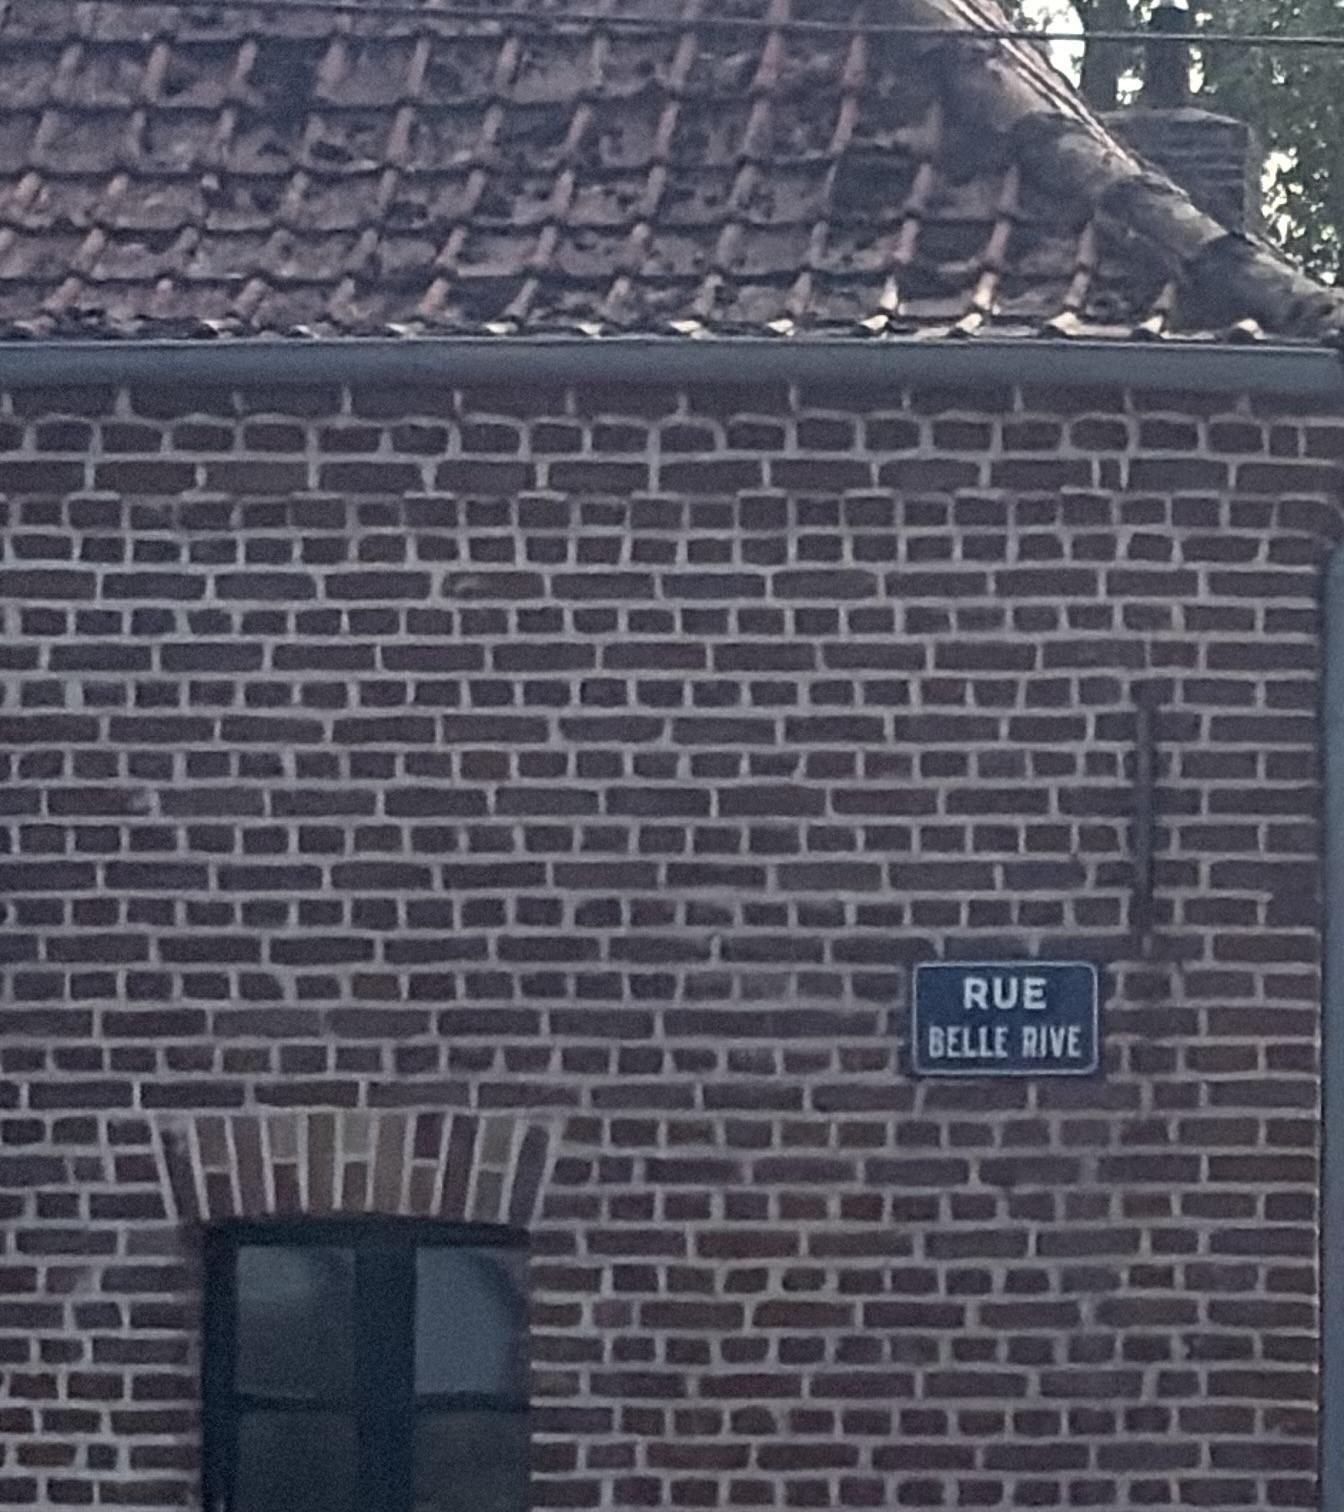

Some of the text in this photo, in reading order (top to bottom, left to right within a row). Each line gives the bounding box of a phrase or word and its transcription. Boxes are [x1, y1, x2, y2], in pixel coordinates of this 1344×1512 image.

[963, 976, 1048, 1010] RUE
[928, 1025, 1082, 1058] BELLE RIVE
